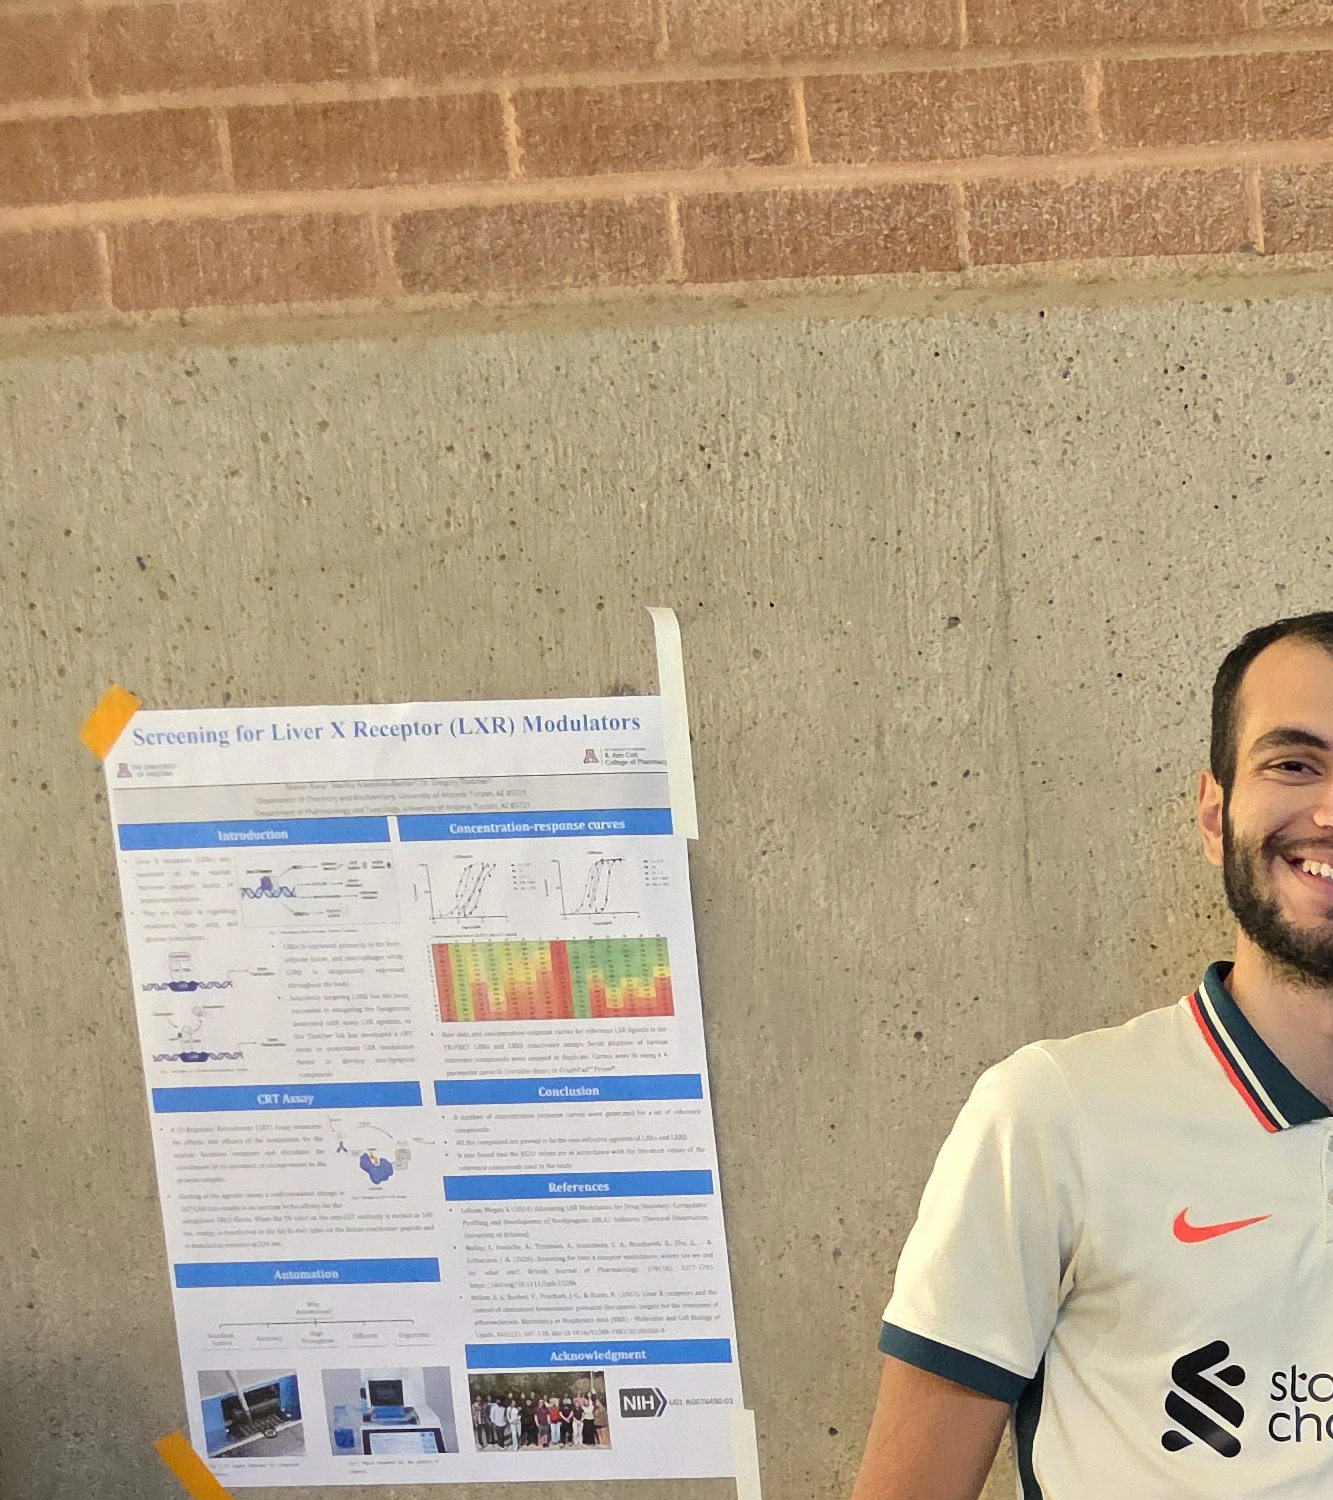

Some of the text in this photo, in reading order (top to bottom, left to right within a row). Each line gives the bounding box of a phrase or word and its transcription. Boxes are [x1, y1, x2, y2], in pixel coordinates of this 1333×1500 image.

[133, 714, 641, 748] Screening for Liver X Receptor (LXR) Modulators
[449, 818, 625, 835] Concentration-response curves
[217, 827, 289, 841] Introduction
[538, 1085, 600, 1097] Conclusion
[256, 1093, 314, 1106] CRT Assay
[548, 1181, 609, 1193] References
[274, 1269, 339, 1280] Automation
[550, 1349, 647, 1363] Acknowledgment
[623, 1394, 655, 1411] NIH
